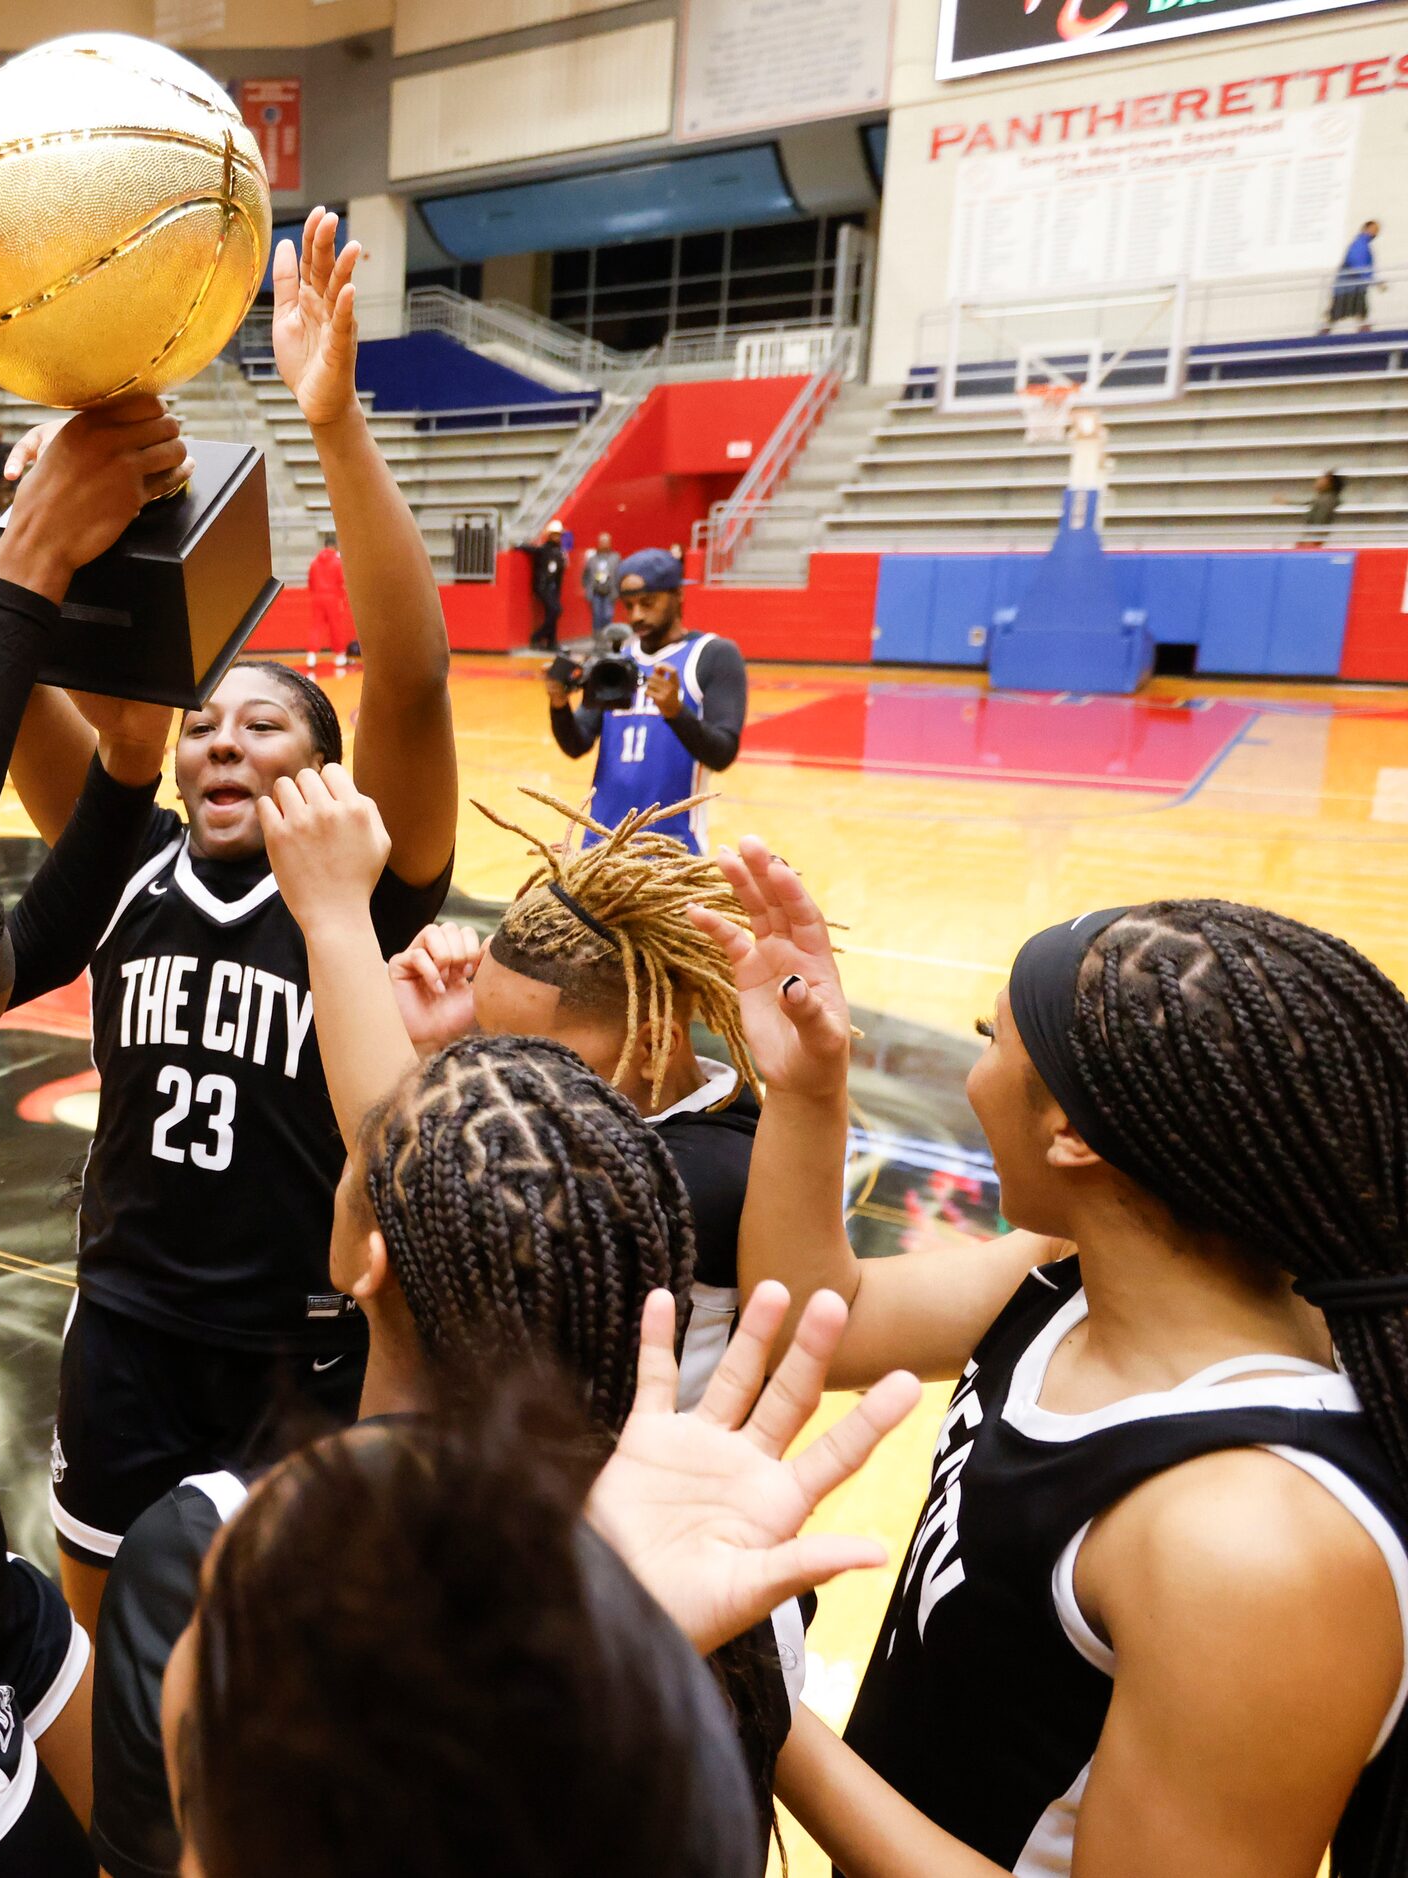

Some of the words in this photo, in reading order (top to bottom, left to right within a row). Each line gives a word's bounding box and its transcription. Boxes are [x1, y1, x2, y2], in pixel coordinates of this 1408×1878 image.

[620, 725, 648, 763] 11
[120, 956, 199, 1049] THE
[202, 960, 314, 1079] CITY
[151, 1064, 237, 1173] 23
